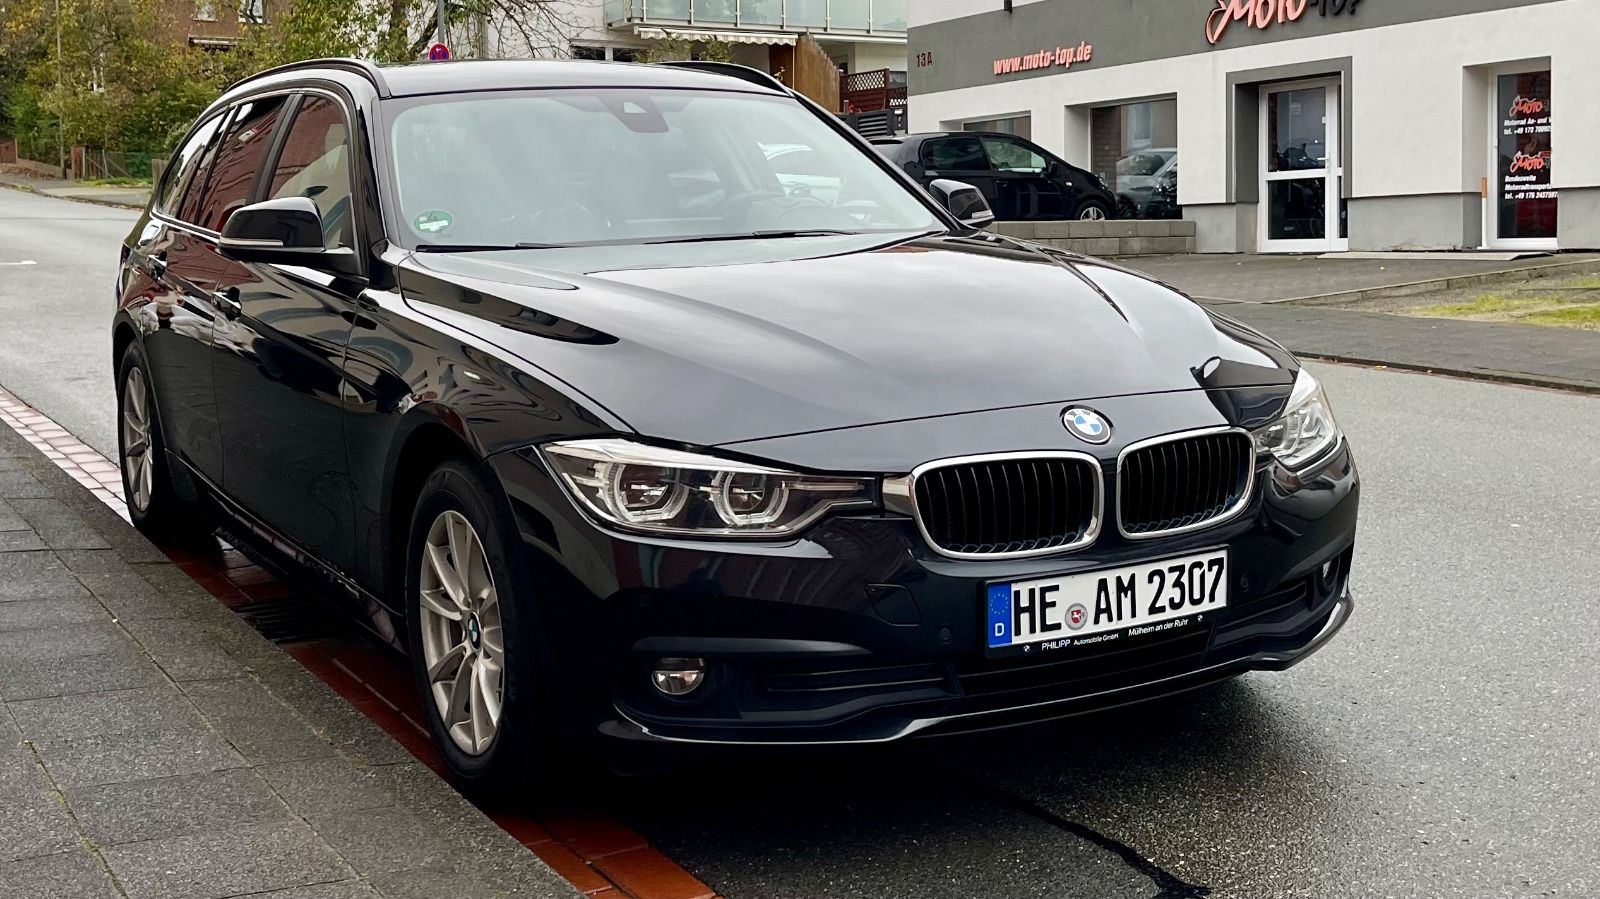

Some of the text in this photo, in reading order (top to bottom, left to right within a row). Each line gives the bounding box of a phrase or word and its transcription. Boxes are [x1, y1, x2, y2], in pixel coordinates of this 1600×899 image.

[993, 41, 1093, 75] www.moto-top.de
[1013, 556, 1226, 637] HE AM 2307
[994, 623, 1005, 637] D
[1041, 618, 1189, 651] PHILIPP Automobile GmbH Mülheim an der Ruhr
